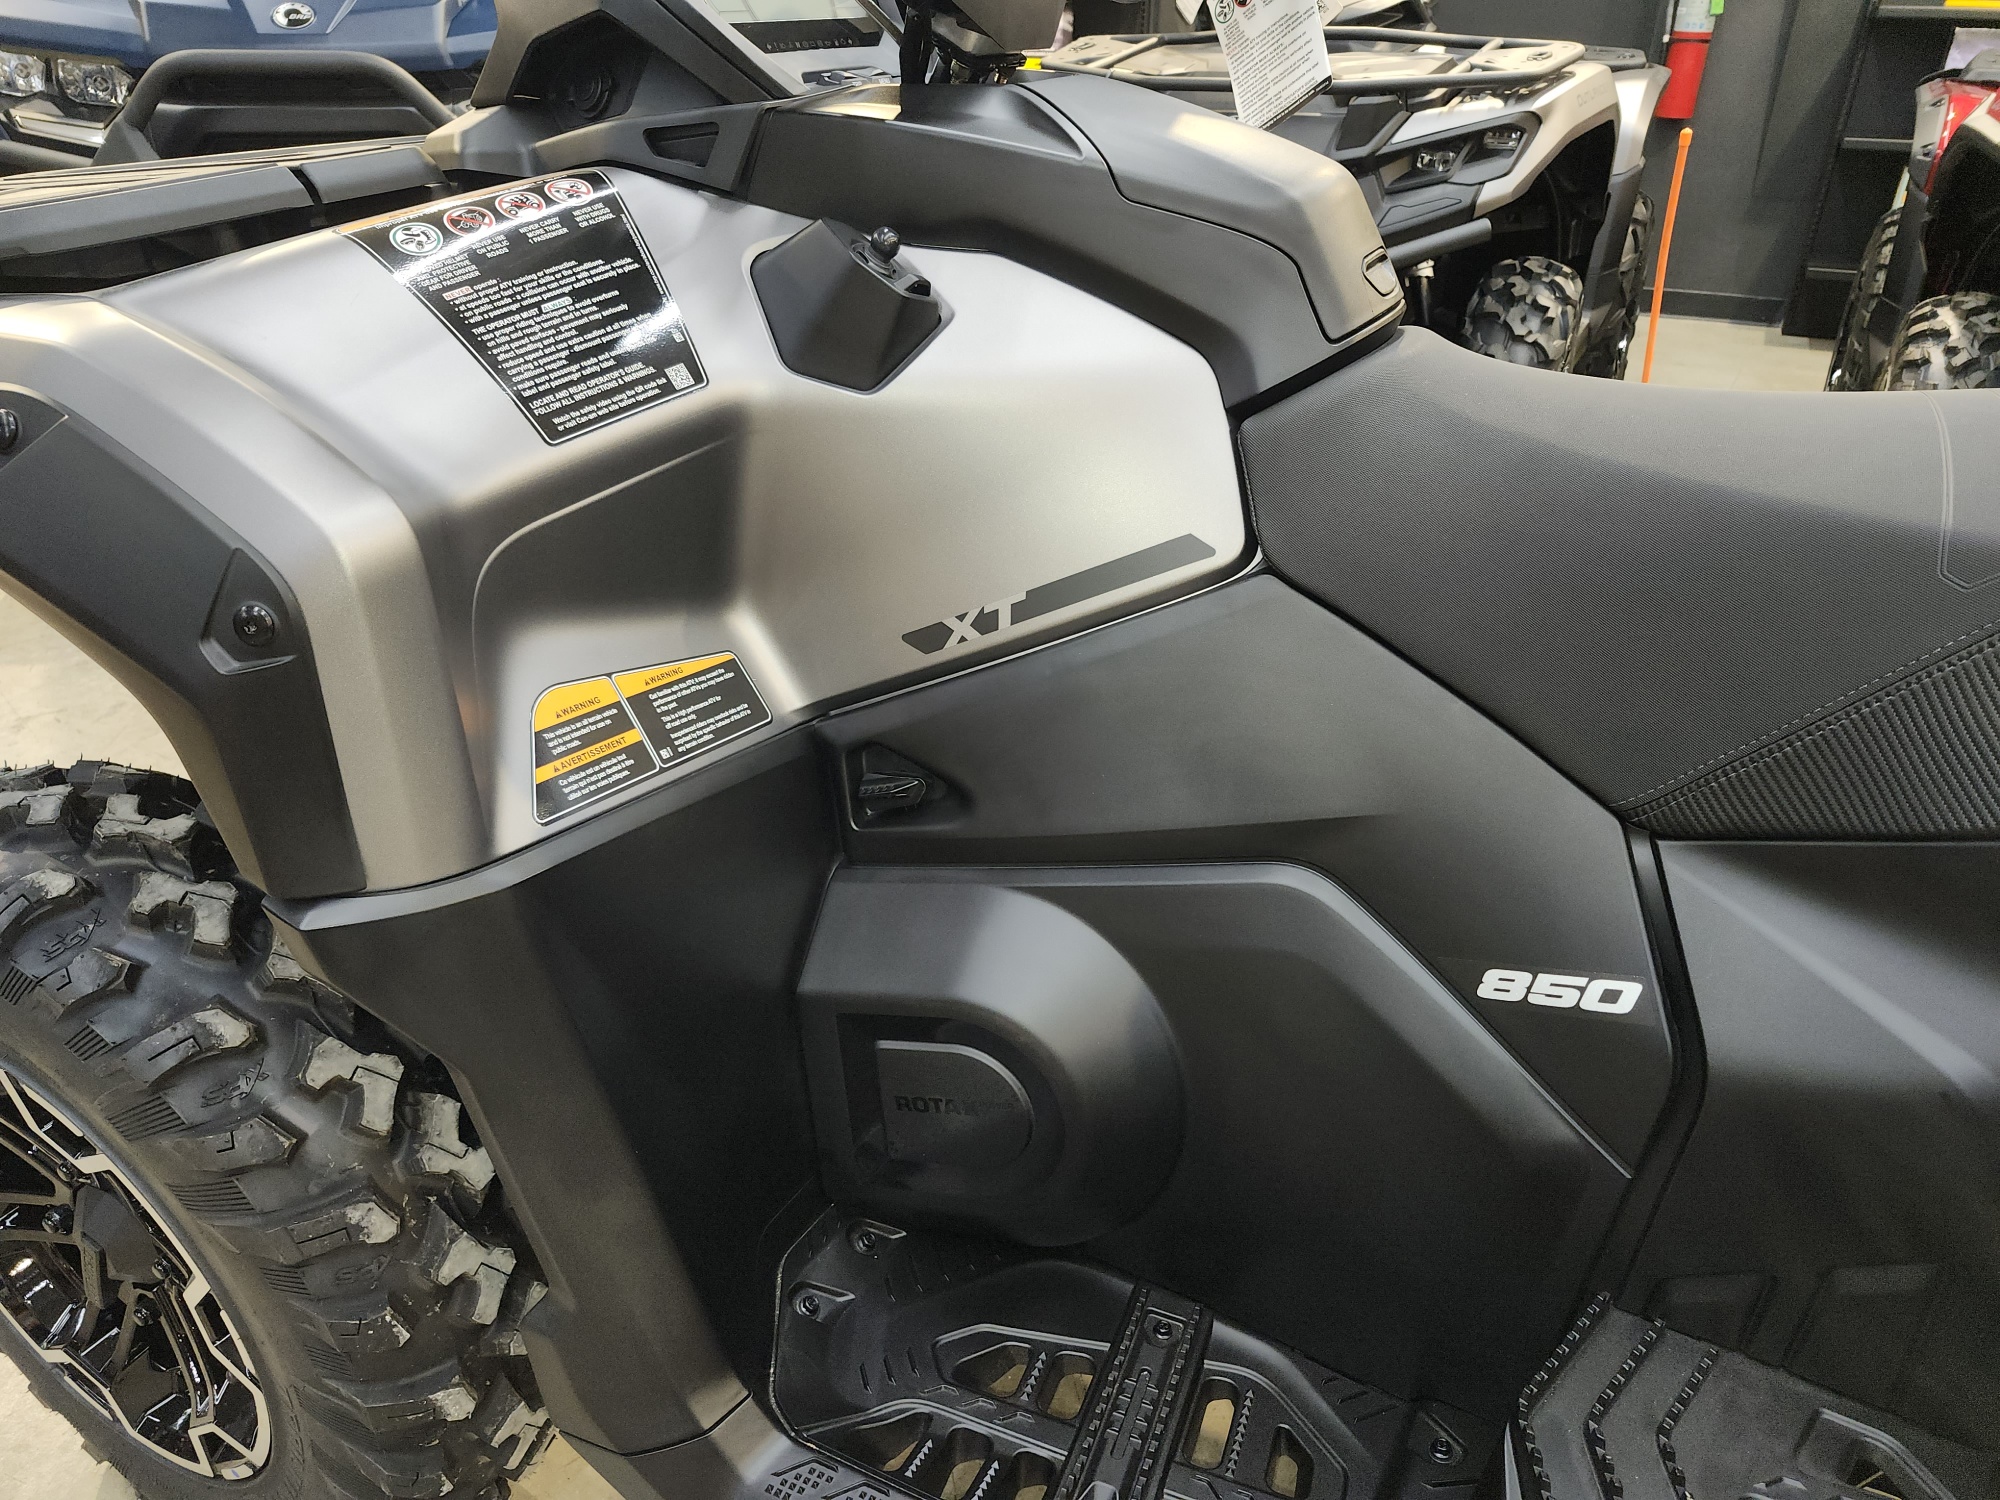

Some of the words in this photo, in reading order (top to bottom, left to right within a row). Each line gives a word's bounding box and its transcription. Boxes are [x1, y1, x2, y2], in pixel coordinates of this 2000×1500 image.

[519, 224, 540, 233] NEVER
[540, 217, 559, 226] CARRY
[573, 207, 592, 216] NEVER
[589, 213, 615, 224] ALCOHOL
[590, 208, 610, 217] DRUGS
[470, 239, 493, 249] NEVER
[487, 240, 509, 251] PUBLIC
[527, 229, 545, 237] MORE
[544, 223, 561, 231] THAN
[533, 228, 568, 242] PASSENGER
[432, 260, 471, 276] PROTECTIVE
[442, 254, 468, 265] HELMET
[486, 248, 509, 258] ROADS
[421, 278, 440, 286] GEAR
[453, 265, 477, 275] DRIVER
[443, 271, 480, 286] PASSENGER
[445, 287, 471, 299] NEVER
[474, 280, 497, 290] operate
[454, 293, 478, 304] without
[478, 286, 499, 297] proper
[500, 281, 512, 289] ATV
[513, 274, 537, 284] training
[544, 261, 577, 274] instruction.
[467, 298, 490, 308] speeds
[523, 281, 538, 290] your
[539, 276, 555, 284] skills
[573, 260, 604, 272] conditions.
[474, 304, 493, 315] public
[494, 298, 512, 307] roads
[521, 286, 547, 297] collision
[559, 276, 576, 285] occur
[590, 265, 611, 274] another
[612, 258, 633, 267] vehicle.
[489, 303, 520, 317] passenger
[521, 296, 542, 305] unless
[542, 285, 572, 300] passenger
[573, 280, 587, 288] seat
[593, 271, 617, 281] securely
[623, 264, 640, 272] place.
[472, 326, 487, 334] THE
[486, 315, 521, 330] OPERATOR
[521, 308, 539, 318] MUST
[543, 298, 570, 311] ALWAYS
[492, 344, 510, 354] avoid
[510, 338, 529, 349] paved
[530, 329, 556, 341] surfaces
[560, 317, 589, 332] pavement
[602, 304, 628, 316] seriously
[494, 326, 515, 337] proper
[516, 319, 535, 328] riding
[534, 308, 567, 322] techniques
[575, 299, 591, 308] avoid
[592, 291, 619, 302] overturns
[510, 330, 523, 339] and
[523, 325, 542, 334] rough
[541, 318, 562, 328] terrain
[562, 313, 574, 321] and
[581, 306, 599, 314] turns.
[497, 351, 515, 361] affect
[515, 342, 543, 354] handling
[543, 337, 555, 345] and
[555, 329, 578, 340] control.
[503, 358, 524, 368] reduce
[524, 350, 544, 360] speed
[544, 346, 556, 354] and
[568, 337, 584, 345] extra
[584, 329, 606, 339] caution
[620, 318, 636, 327] times
[636, 313, 652, 321] when
[508, 363, 534, 375] carrying
[539, 350, 569, 365] passenger
[574, 338, 602, 351] dismount
[513, 368, 544, 382] conditions
[545, 360, 568, 370] require.
[518, 381, 534, 390] make
[550, 364, 580, 379] passenger
[581, 358, 598, 366] reads
[598, 352, 610, 361] and
[521, 387, 538, 397] label
[538, 383, 550, 391] and
[551, 372, 581, 387] passenger
[582, 366, 600, 375] safety
[600, 359, 616, 368] label.
[529, 395, 555, 408] LOCATE
[555, 390, 569, 399] AND
[569, 384, 587, 394] READ
[587, 369, 625, 387] OPERATOR'S
[625, 362, 645, 373] GUIDE.
[534, 402, 561, 415] FOLLOW
[562, 398, 575, 406] ALL
[574, 381, 618, 400] INSTRUCTIONS
[623, 367, 656, 382] WARNINGS.
[553, 415, 571, 424] Watch
[580, 405, 596, 414] safety
[597, 399, 611, 407] video
[612, 394, 627, 402] using
[565, 420, 577, 428] visit
[576, 413, 597, 423] Can-am
[618, 398, 636, 407] before
[636, 389, 661, 401] operation.
[942, 591, 1026, 649] XT
[651, 667, 684, 686] WARNING
[561, 696, 601, 716] WARNING
[561, 737, 627, 771] AVERTISSEMENT
[1476, 968, 1643, 1014] 850
